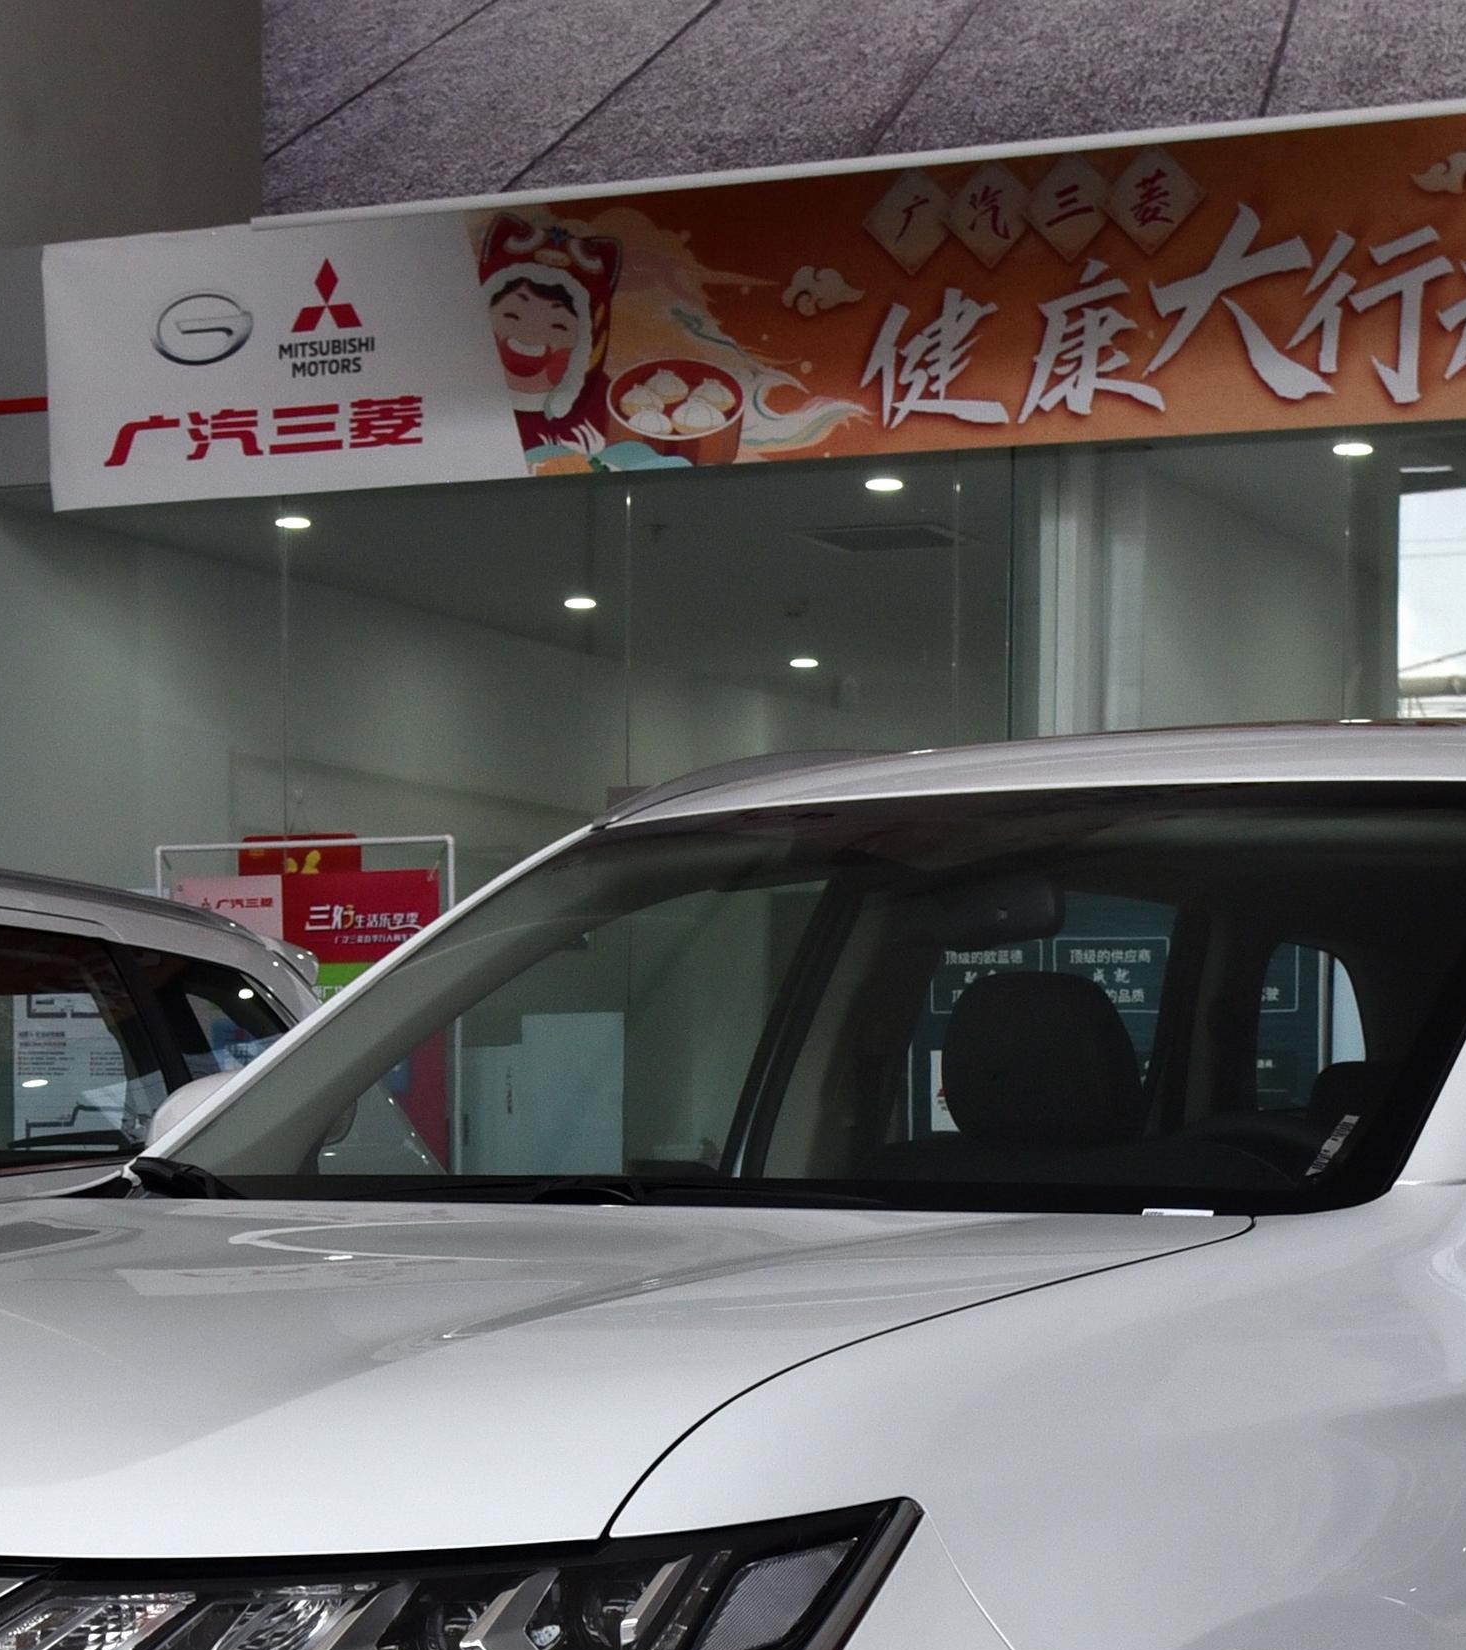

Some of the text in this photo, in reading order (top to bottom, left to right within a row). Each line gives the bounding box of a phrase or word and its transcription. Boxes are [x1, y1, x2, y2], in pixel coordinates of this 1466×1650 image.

[894, 169, 1177, 242] 广汽三菱
[278, 335, 375, 361] MITSUBISHI
[291, 356, 362, 378] MOTORS
[104, 394, 422, 468] 广汽三菱
[1070, 949, 1152, 965] 顶级的供应商
